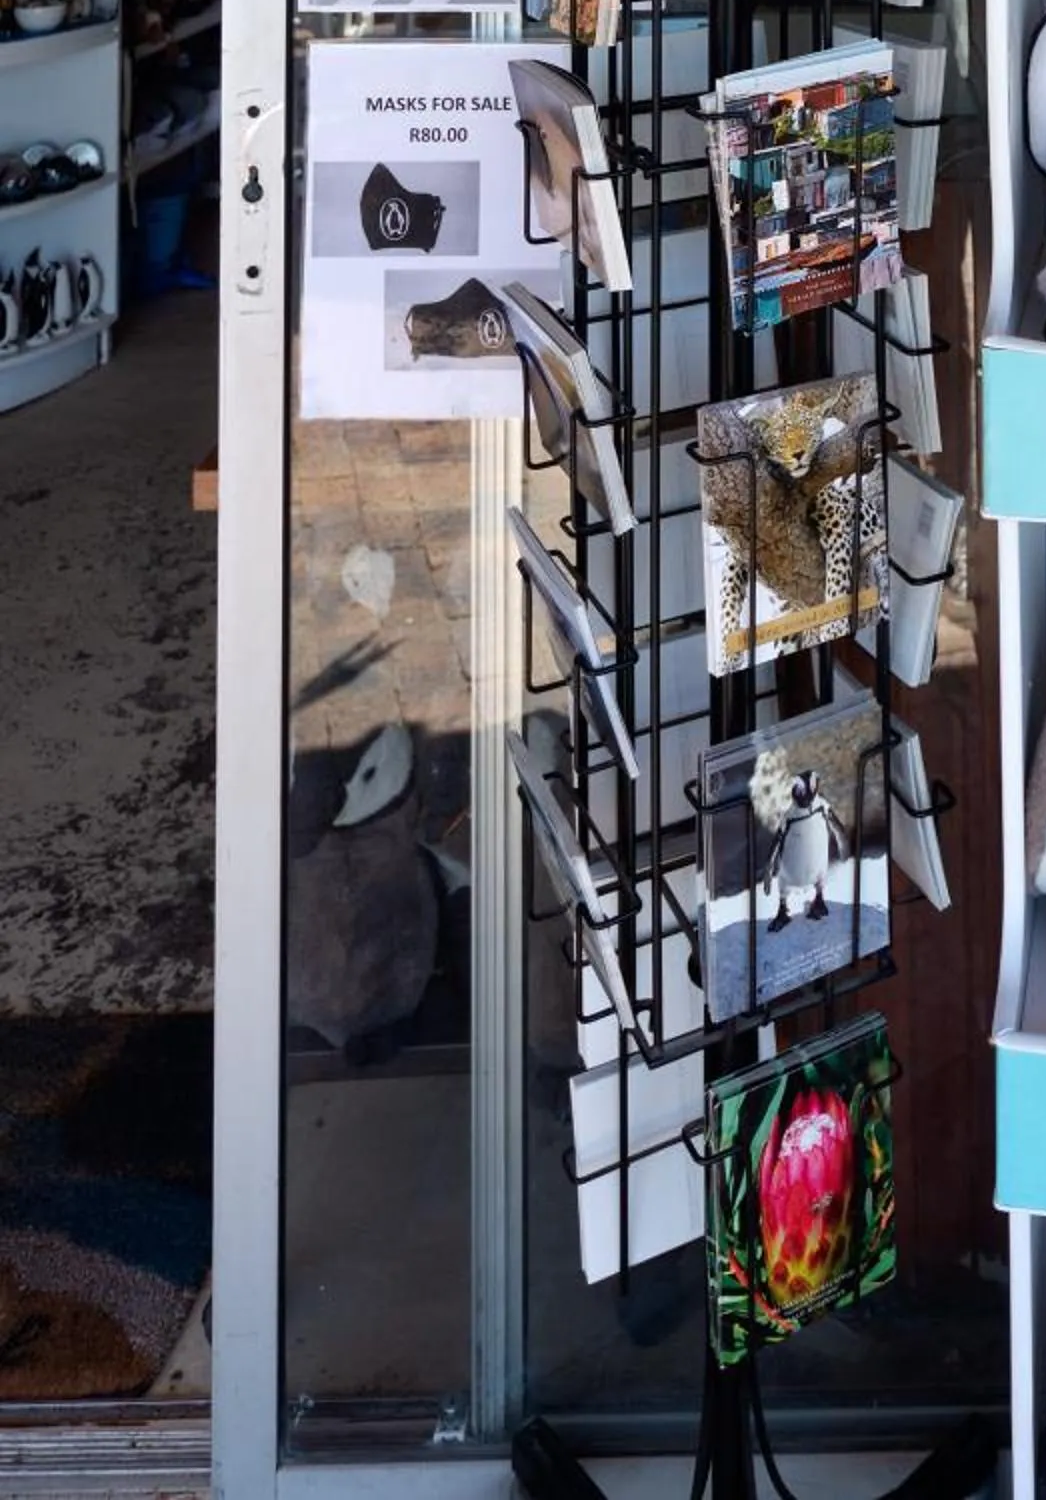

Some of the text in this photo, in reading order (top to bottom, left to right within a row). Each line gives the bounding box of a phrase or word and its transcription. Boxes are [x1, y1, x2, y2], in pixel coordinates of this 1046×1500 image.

[366, 97, 512, 112] MASKS FOR SALE
[409, 127, 469, 143] R80.00
